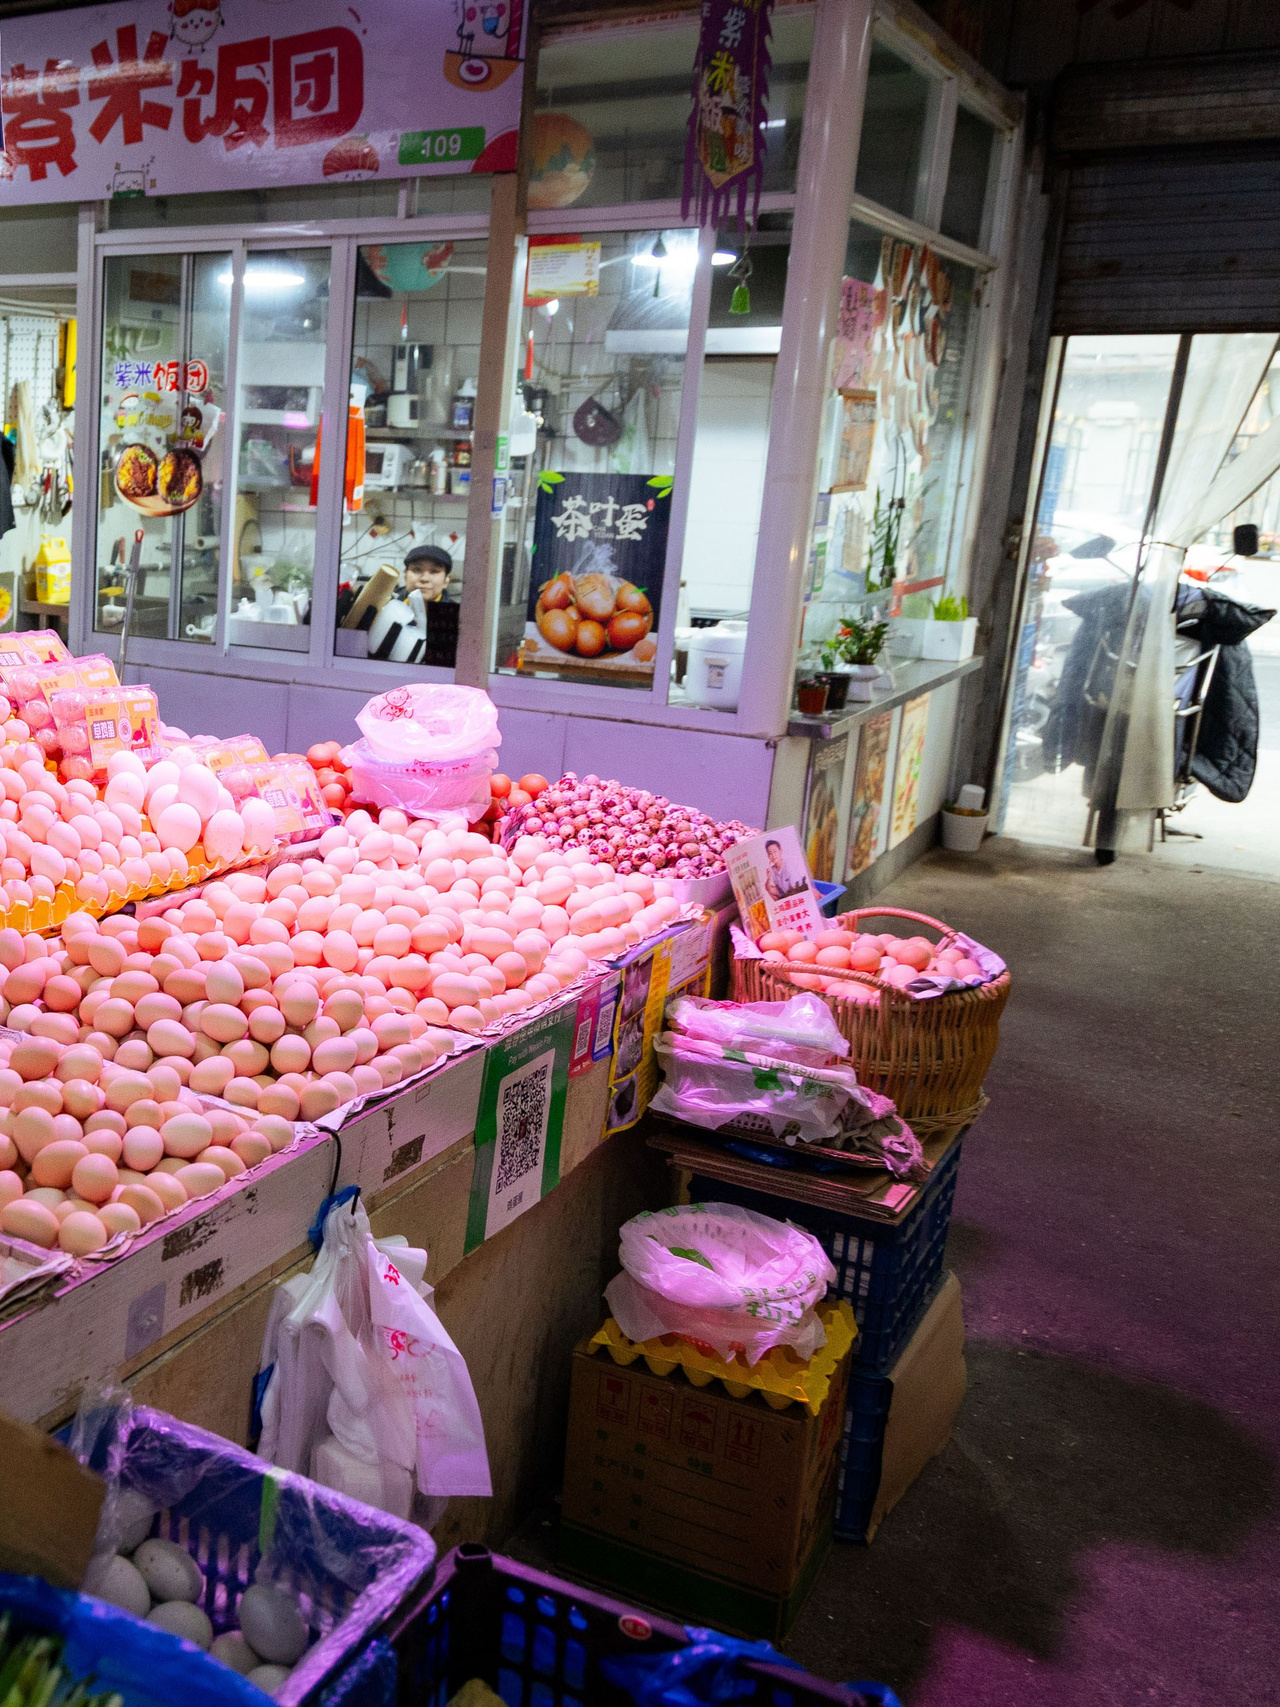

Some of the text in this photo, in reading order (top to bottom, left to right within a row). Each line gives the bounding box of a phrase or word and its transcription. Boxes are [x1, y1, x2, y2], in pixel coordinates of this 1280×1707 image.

[1, 25, 363, 182] 紫米饭团
[422, 133, 462, 158] 109
[114, 359, 210, 393] 紫米饭团
[551, 494, 650, 542] 茶叶蛋
[92, 720, 116, 740] 草鸡蛋
